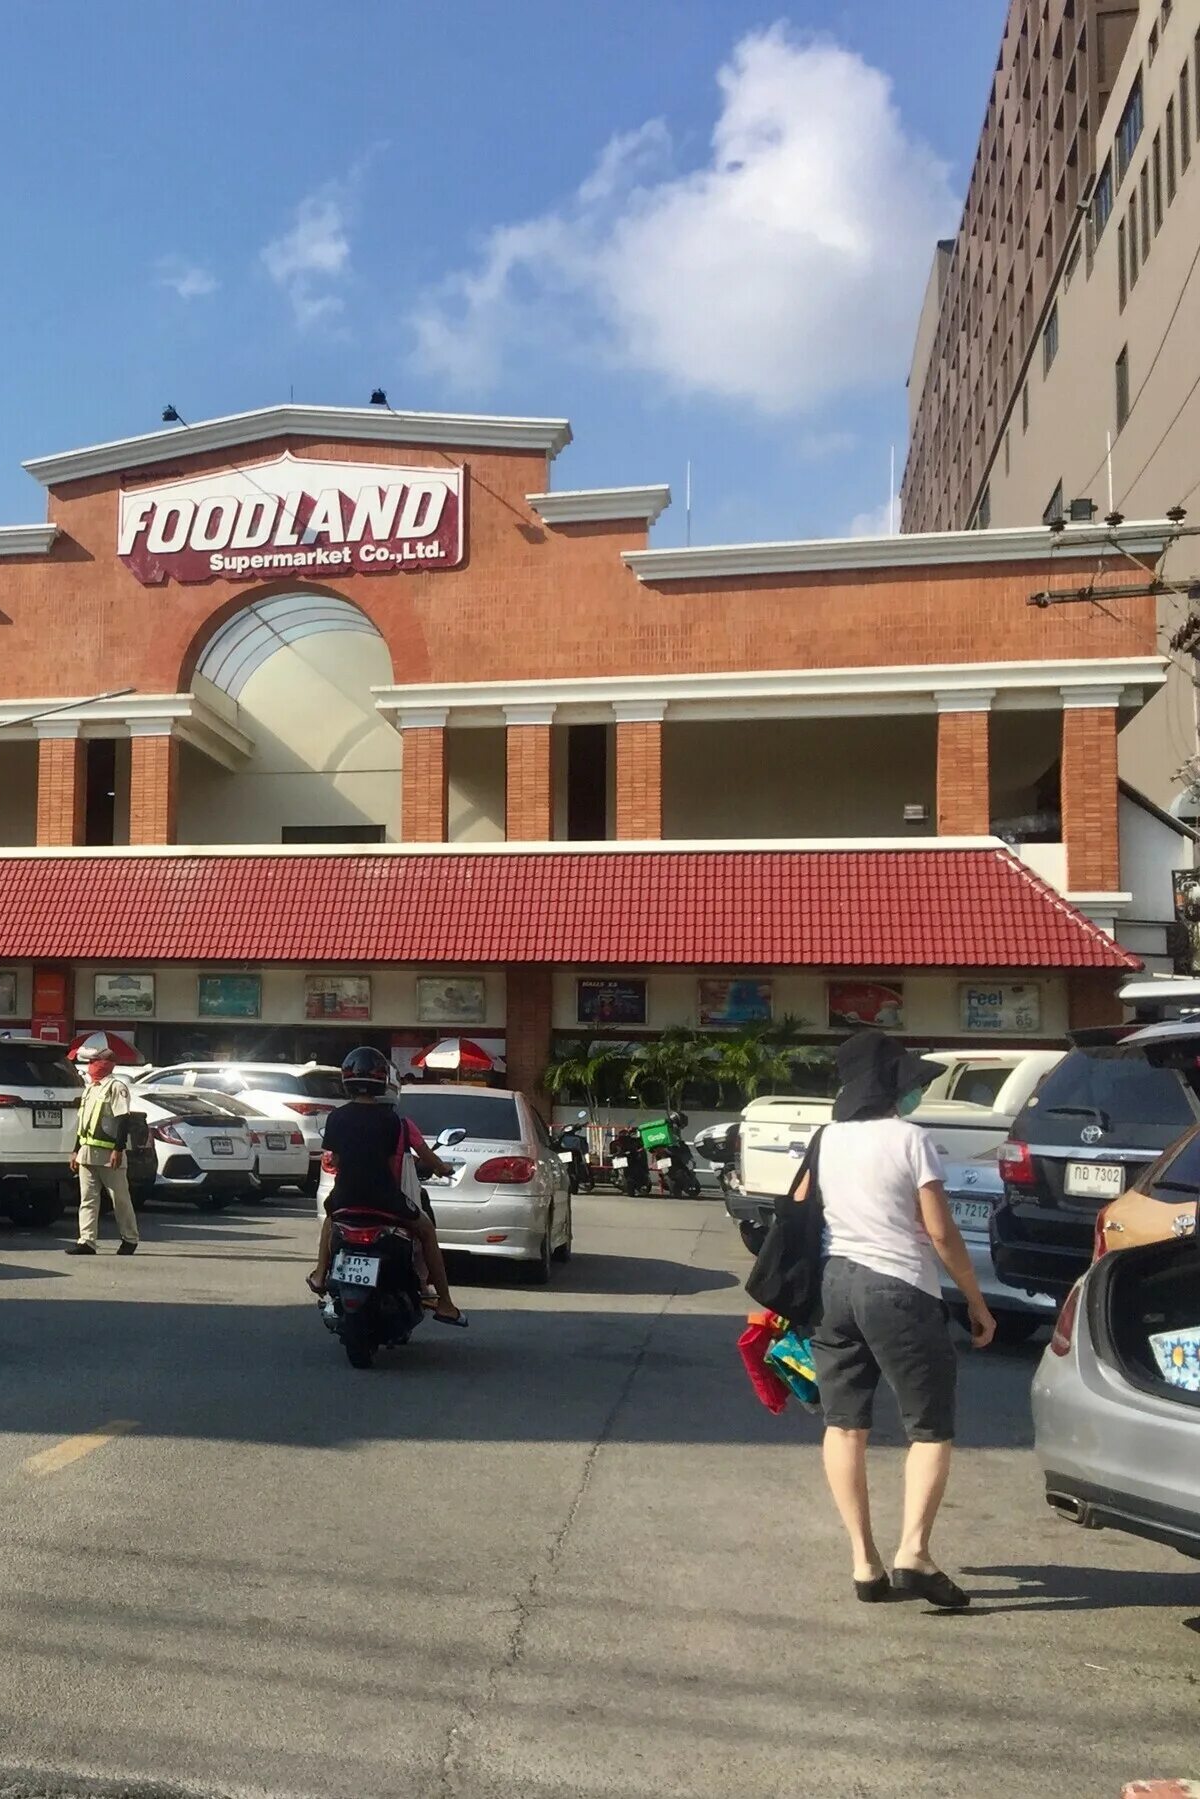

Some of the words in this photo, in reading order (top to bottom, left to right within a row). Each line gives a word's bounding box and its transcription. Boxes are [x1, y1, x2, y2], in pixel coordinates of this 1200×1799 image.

[117, 481, 450, 555] FOODLAND
[209, 548, 352, 574] Supermarket
[359, 541, 446, 564] Co.,Ltd.
[968, 990, 1003, 1006] Feel
[1094, 1167, 1120, 1183] 7302
[965, 1203, 989, 1219] 7212
[338, 1273, 370, 1284] 3190
